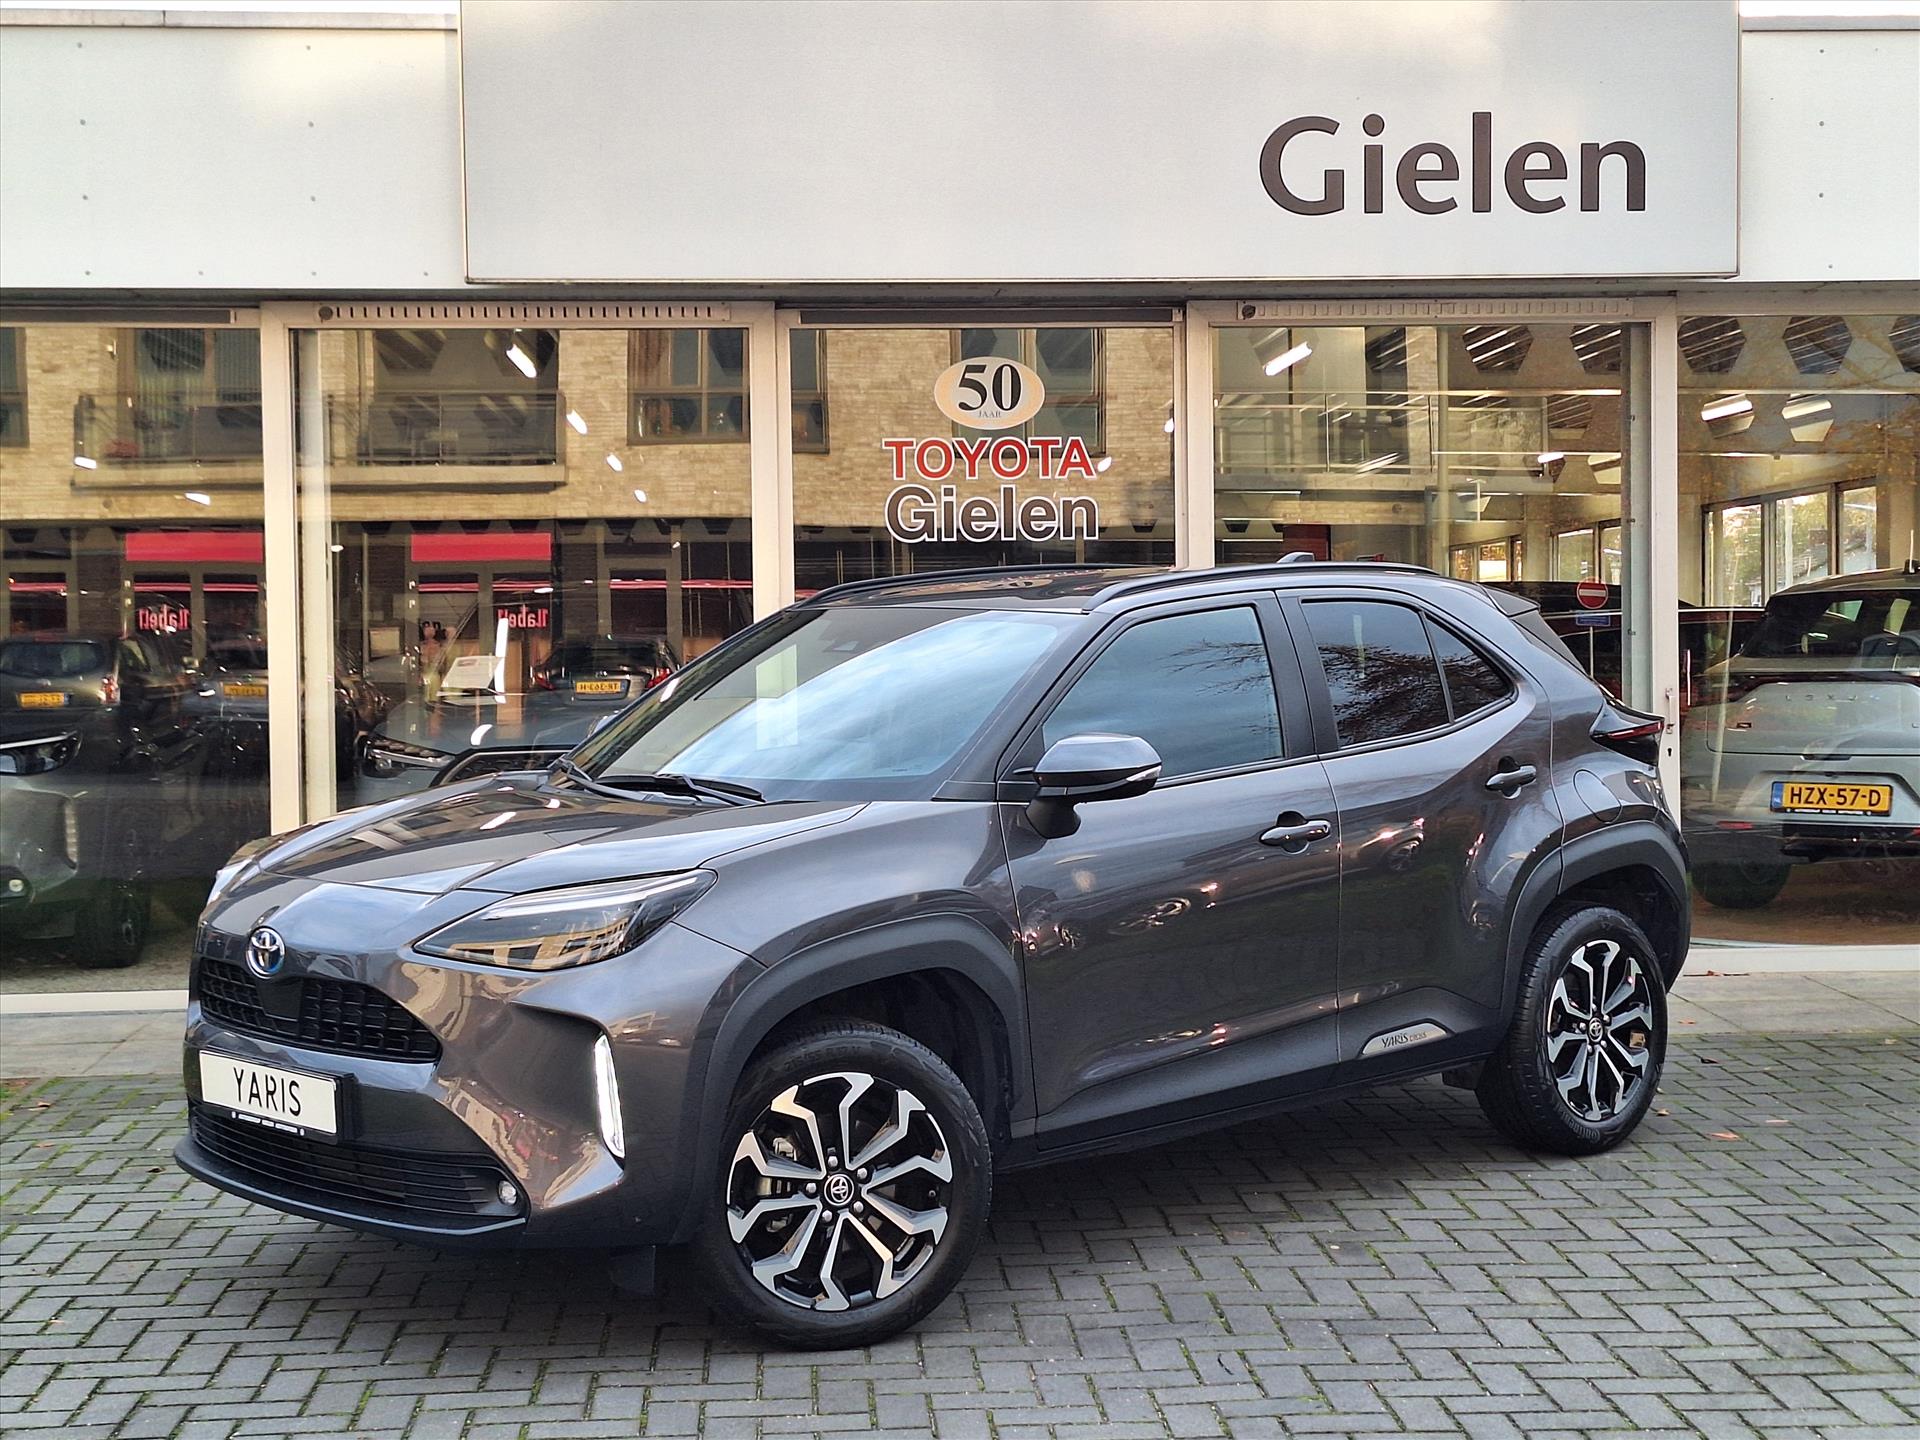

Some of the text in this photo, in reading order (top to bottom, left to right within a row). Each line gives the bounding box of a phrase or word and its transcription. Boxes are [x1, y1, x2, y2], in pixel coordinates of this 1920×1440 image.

[1259, 111, 1647, 215] Gielen
[958, 363, 1022, 411] 50
[978, 410, 1001, 418] JAAR
[882, 437, 1097, 480] TOYOTA
[885, 484, 1099, 542] Gielen
[1790, 787, 1881, 807] HZX-57-D
[233, 1067, 302, 1116] YARIS
